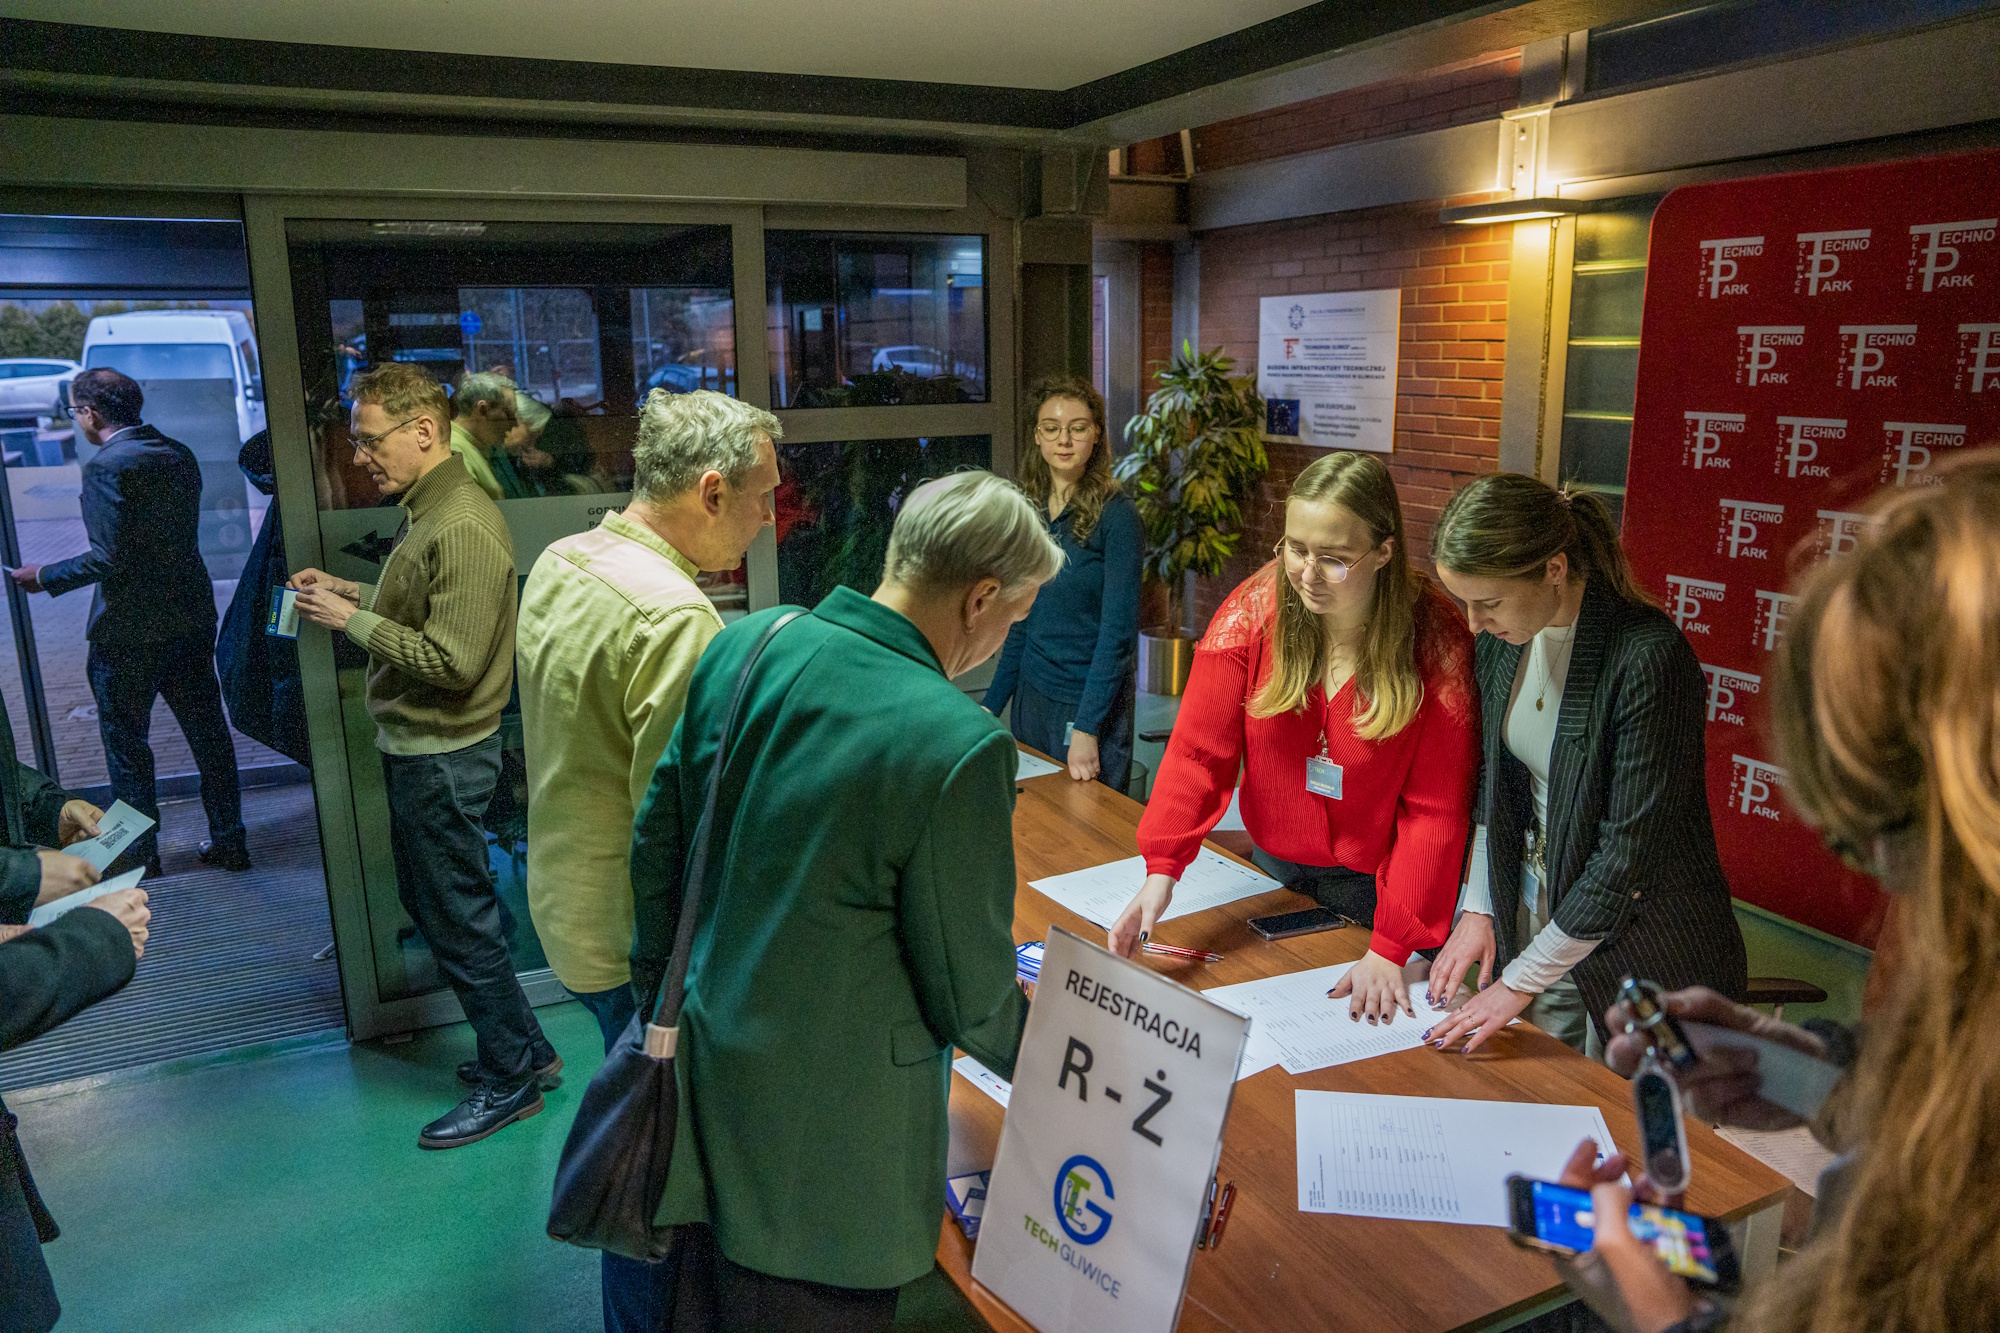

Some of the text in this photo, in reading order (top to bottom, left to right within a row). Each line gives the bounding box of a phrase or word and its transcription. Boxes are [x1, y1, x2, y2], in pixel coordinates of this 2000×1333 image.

[1066, 969, 1202, 1058] REJESTRACJA
[1058, 1036, 1173, 1147] R - Ż
[1024, 1214, 1122, 1299] TECH GLIWICE
